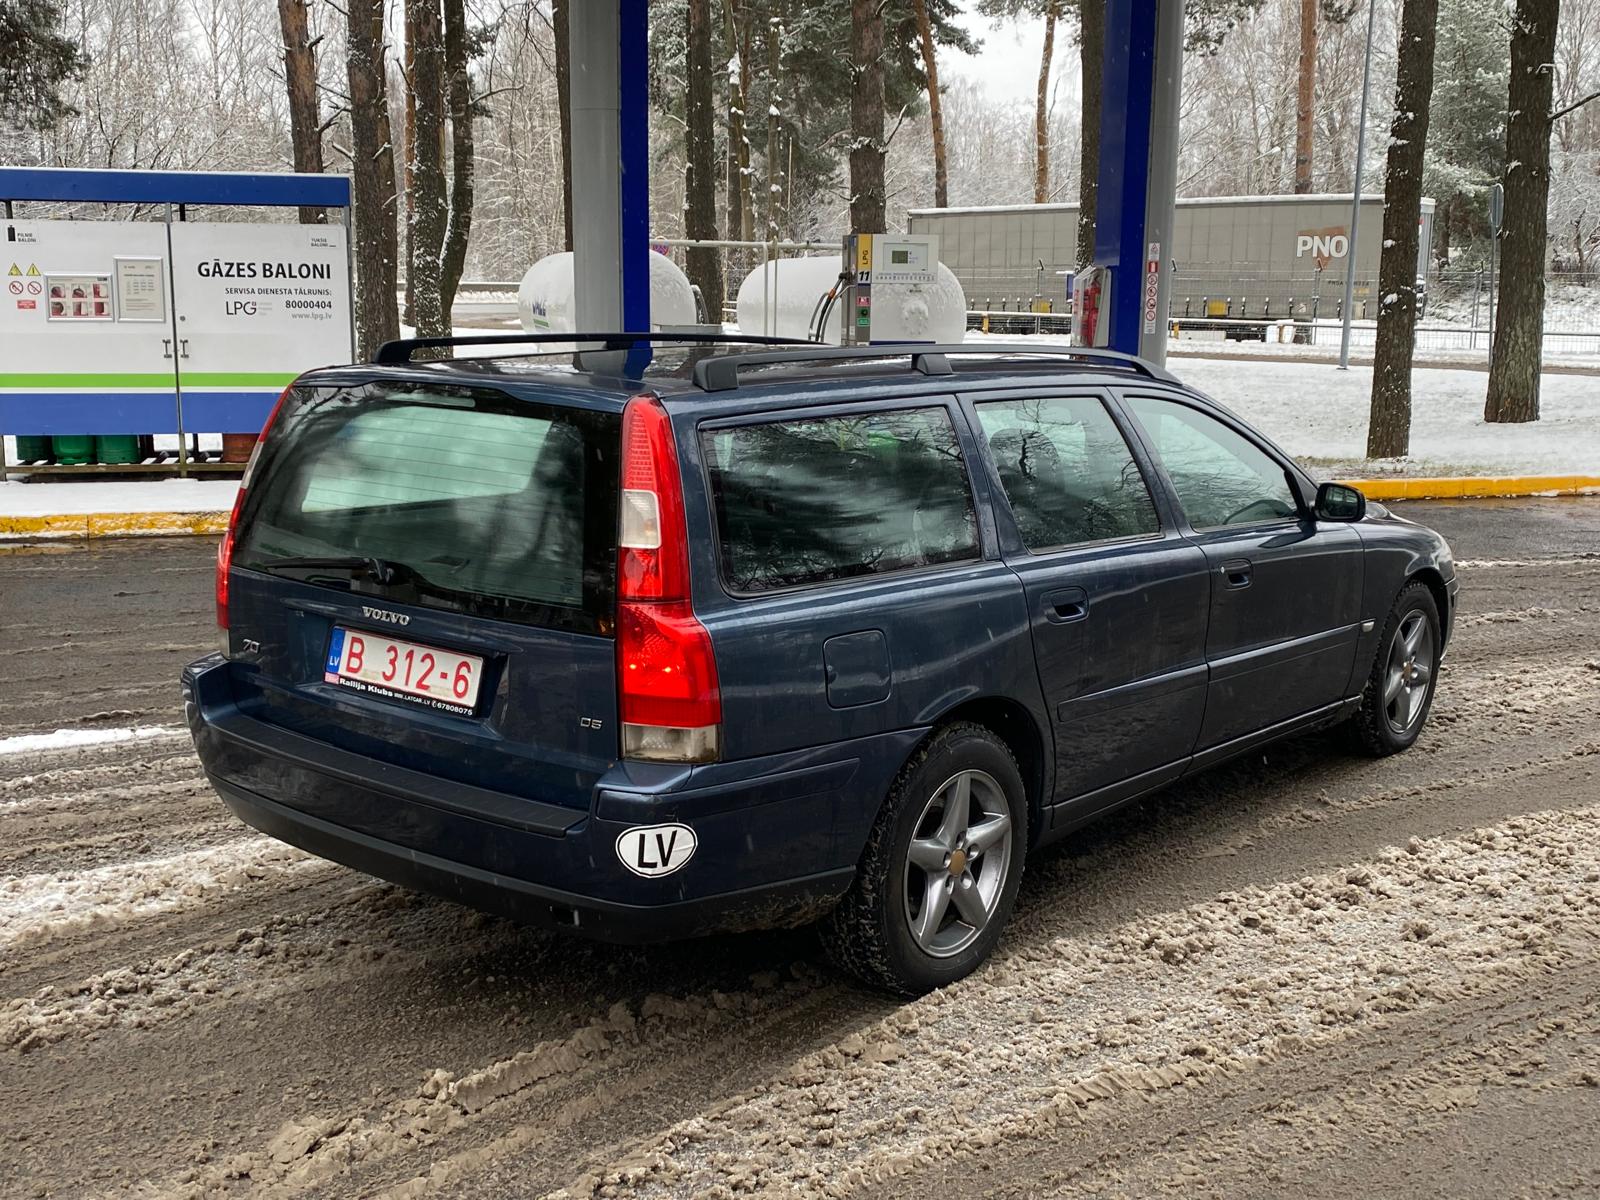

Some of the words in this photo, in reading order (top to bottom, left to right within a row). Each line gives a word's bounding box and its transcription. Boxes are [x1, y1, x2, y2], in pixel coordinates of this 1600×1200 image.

[1296, 235, 1349, 258] PNO
[197, 258, 257, 278] GĀZES
[262, 262, 331, 279] BALONI
[858, 271, 870, 282] 11
[225, 287, 256, 295] SERVISA
[257, 287, 293, 296] DIENESTA
[225, 301, 257, 316] LPG
[285, 300, 332, 309] 80000404
[291, 312, 332, 320] www.lpg.lv
[361, 606, 410, 626] VOLVO
[329, 655, 340, 666] LV
[345, 636, 365, 674] B
[382, 645, 472, 699] 312-6
[339, 677, 366, 691] Rallija
[367, 683, 393, 698] Klubs
[437, 702, 473, 716] 67808075
[580, 717, 603, 730] D5
[638, 830, 677, 868] LV
